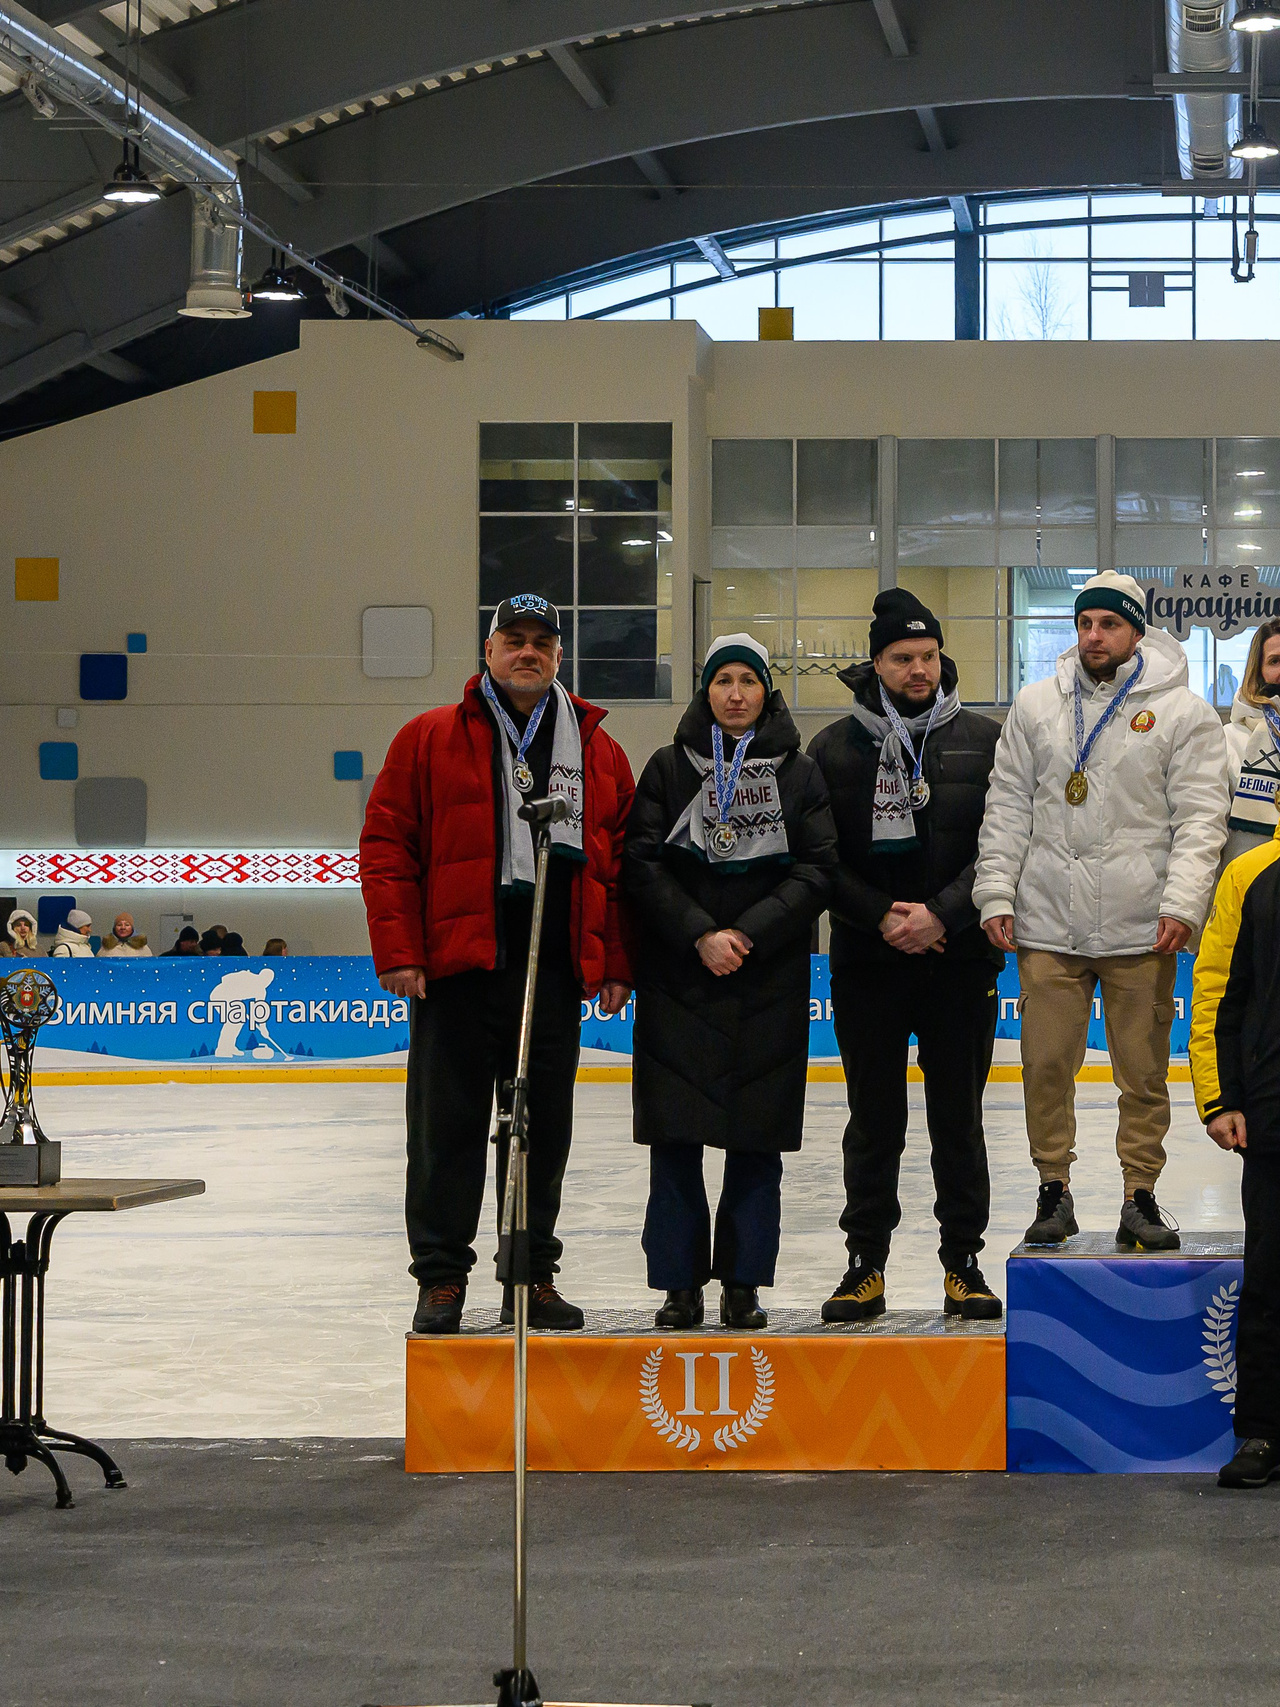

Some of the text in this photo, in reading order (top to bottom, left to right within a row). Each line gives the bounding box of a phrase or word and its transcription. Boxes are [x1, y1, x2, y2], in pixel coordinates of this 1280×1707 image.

[1183, 573, 1250, 589] КАФЕ
[708, 785, 773, 808] ЕИНЫЕ
[1239, 776, 1275, 794] БЕЛЫЕ
[187, 999, 409, 1030] спартакиада
[675, 1352, 739, 1416] II
